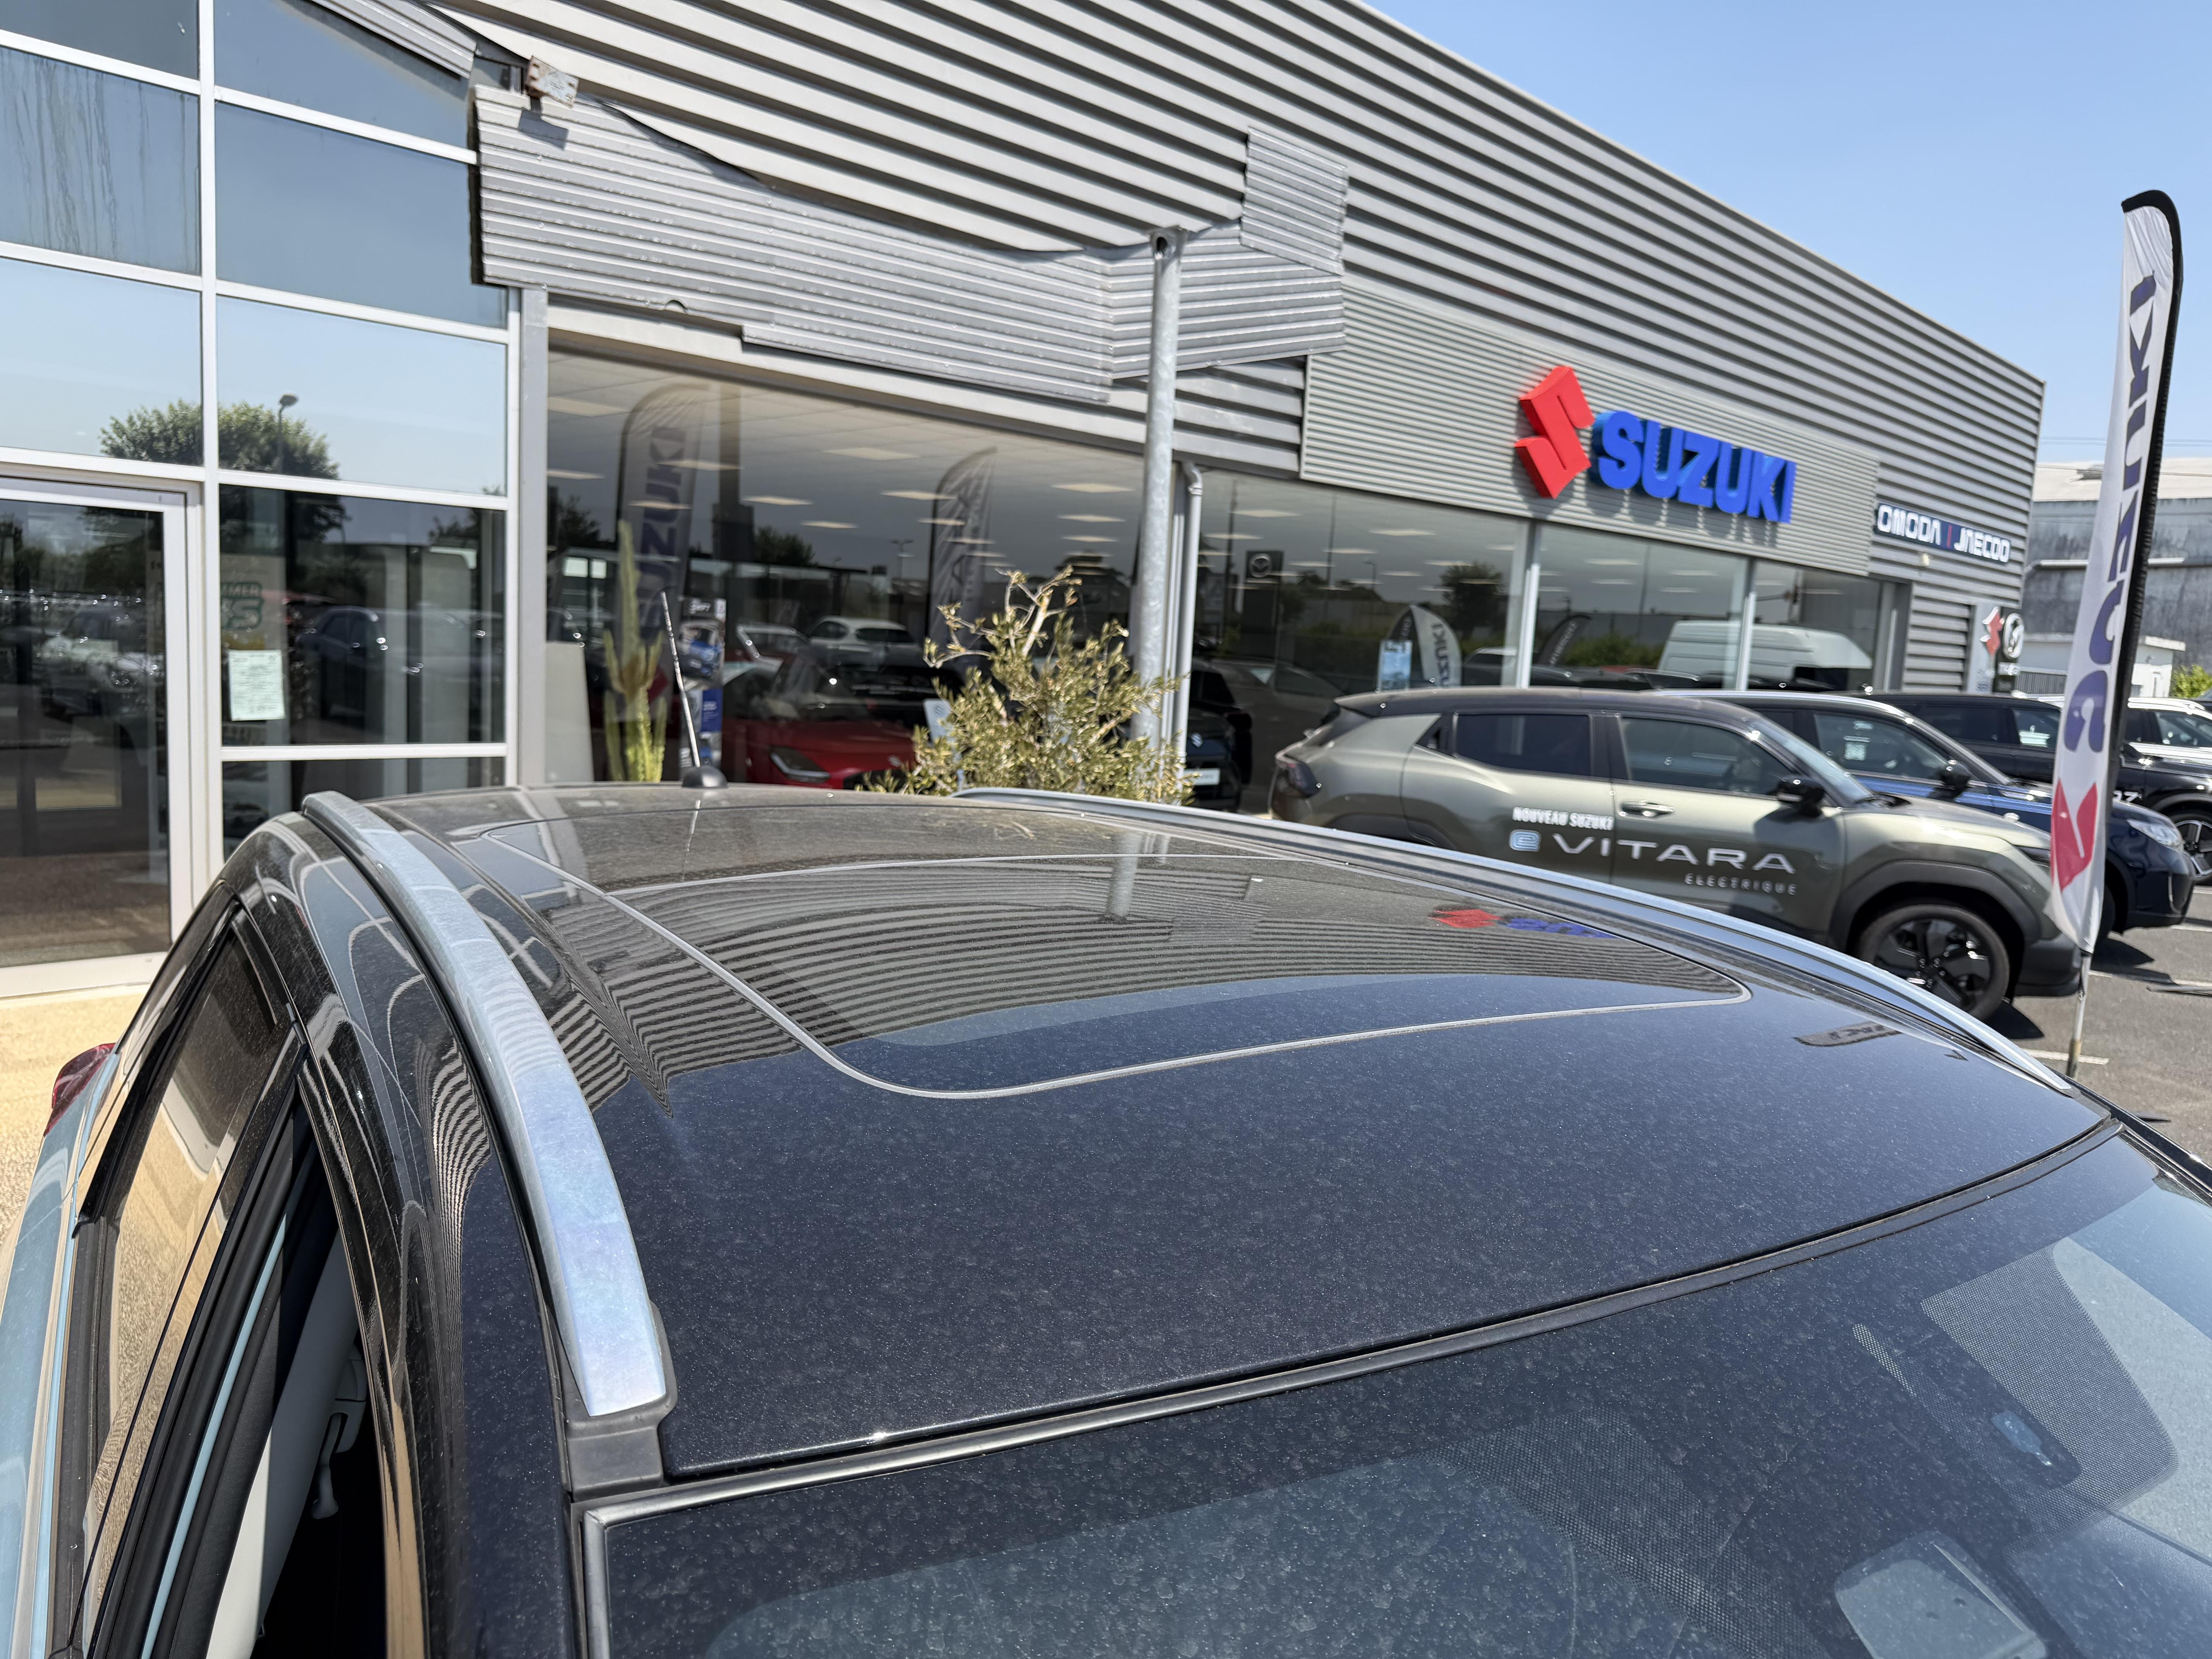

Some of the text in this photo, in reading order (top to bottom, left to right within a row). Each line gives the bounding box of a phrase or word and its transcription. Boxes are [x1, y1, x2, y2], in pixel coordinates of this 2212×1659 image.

[1591, 410, 1797, 524] SUZUKI
[1512, 806, 1614, 831] NOUVEAU SUZUKI
[1552, 833, 1796, 874] VITARA
